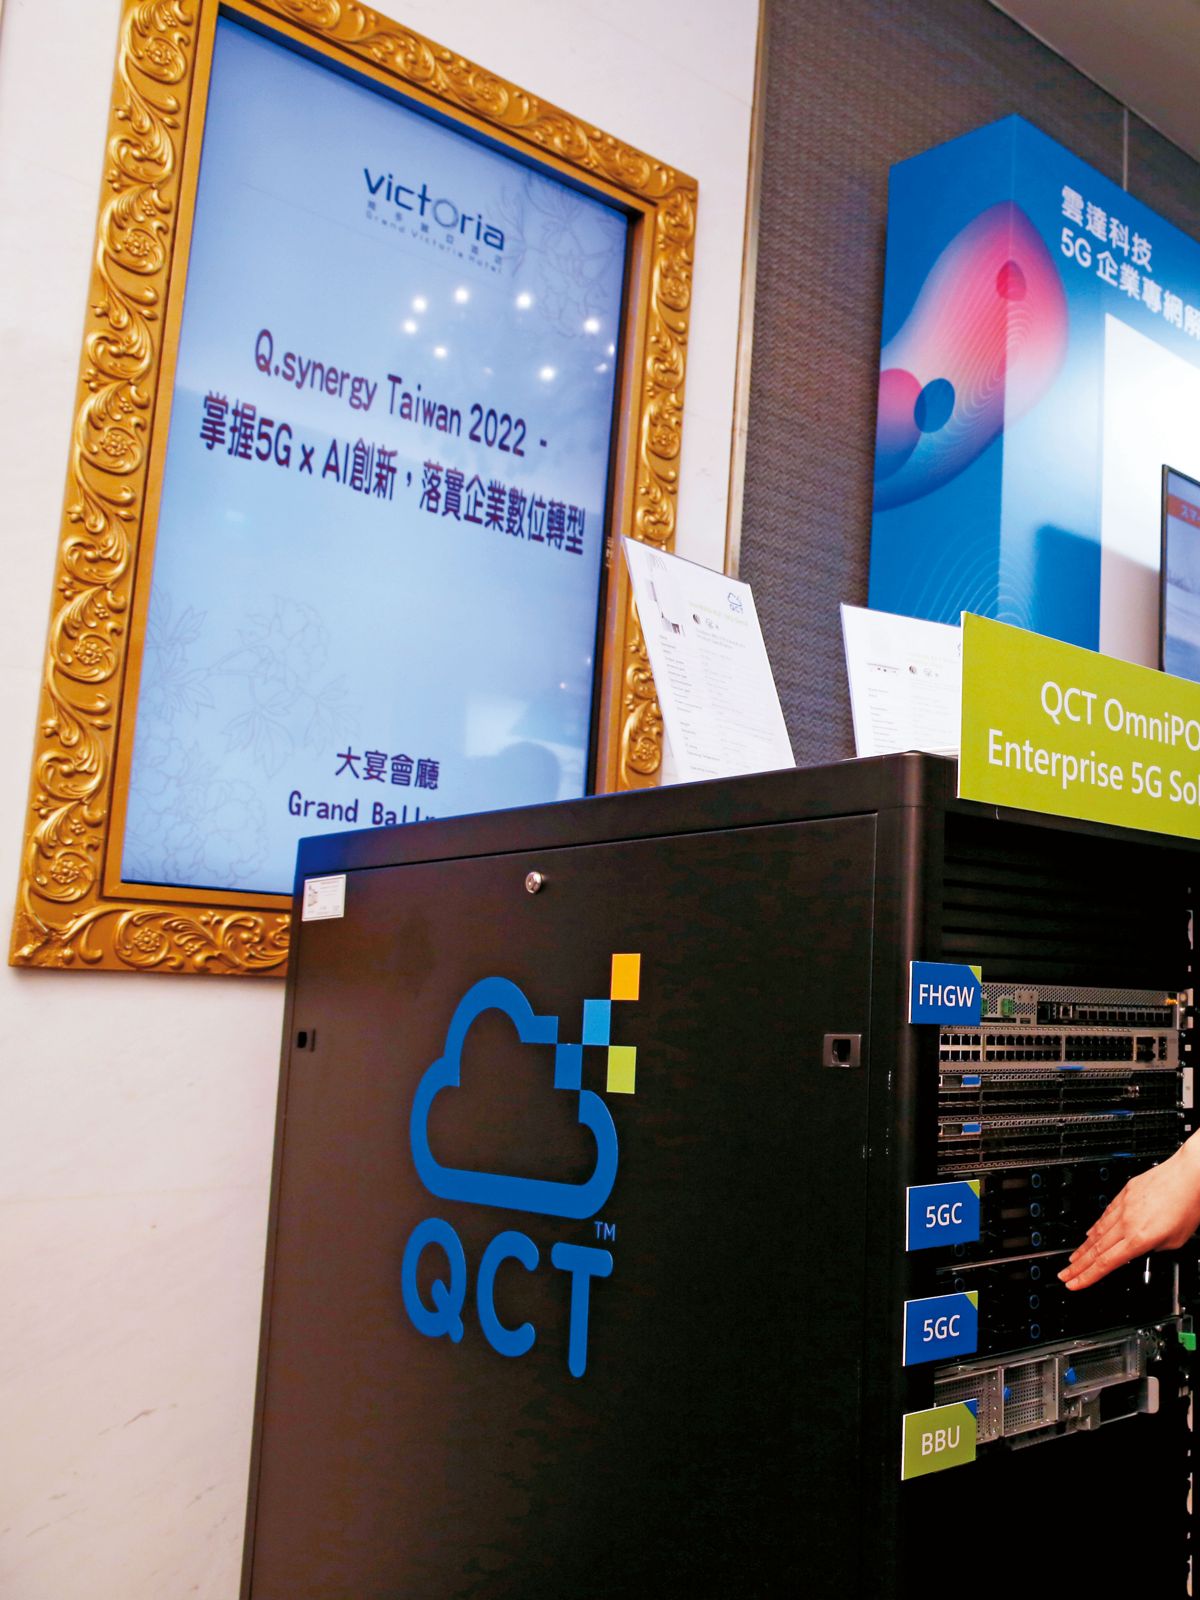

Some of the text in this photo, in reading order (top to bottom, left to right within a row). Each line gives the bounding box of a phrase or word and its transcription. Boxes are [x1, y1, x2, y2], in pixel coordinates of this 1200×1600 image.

[1060, 226, 1092, 269] 5G
[1061, 185, 1153, 273] 雲達科技
[255, 328, 378, 412] Q.synergy
[387, 373, 462, 437] Taiwan
[468, 402, 527, 457] 2022
[1040, 681, 1097, 725] QCT
[335, 746, 440, 790] 大宴會廳
[988, 728, 1124, 790] Enterprise
[1131, 762, 1163, 799] 5G
[288, 790, 359, 824] Grand
[918, 984, 975, 1008] FHGW
[925, 1202, 963, 1228] 5GC
[401, 1217, 614, 1378] QCT
[923, 1314, 961, 1342] 5GC
[921, 1425, 961, 1456] BBU
